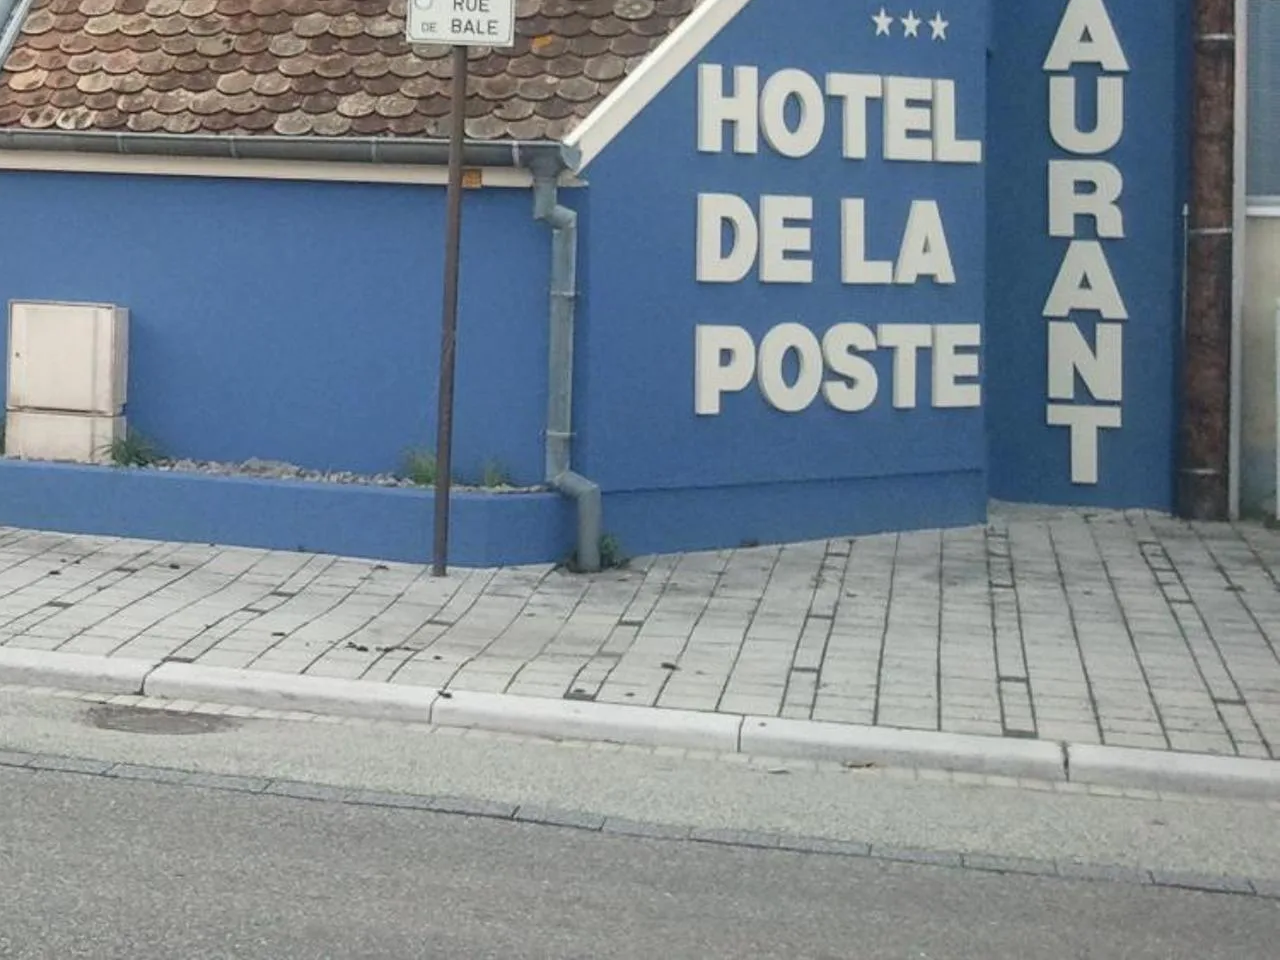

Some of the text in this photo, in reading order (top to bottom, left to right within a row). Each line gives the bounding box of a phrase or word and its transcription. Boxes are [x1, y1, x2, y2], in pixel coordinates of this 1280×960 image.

[421, 19, 499, 35] DE BALE
[697, 63, 982, 163] HOTEL
[696, 192, 957, 284] DE LA
[695, 321, 981, 415] POSTE
